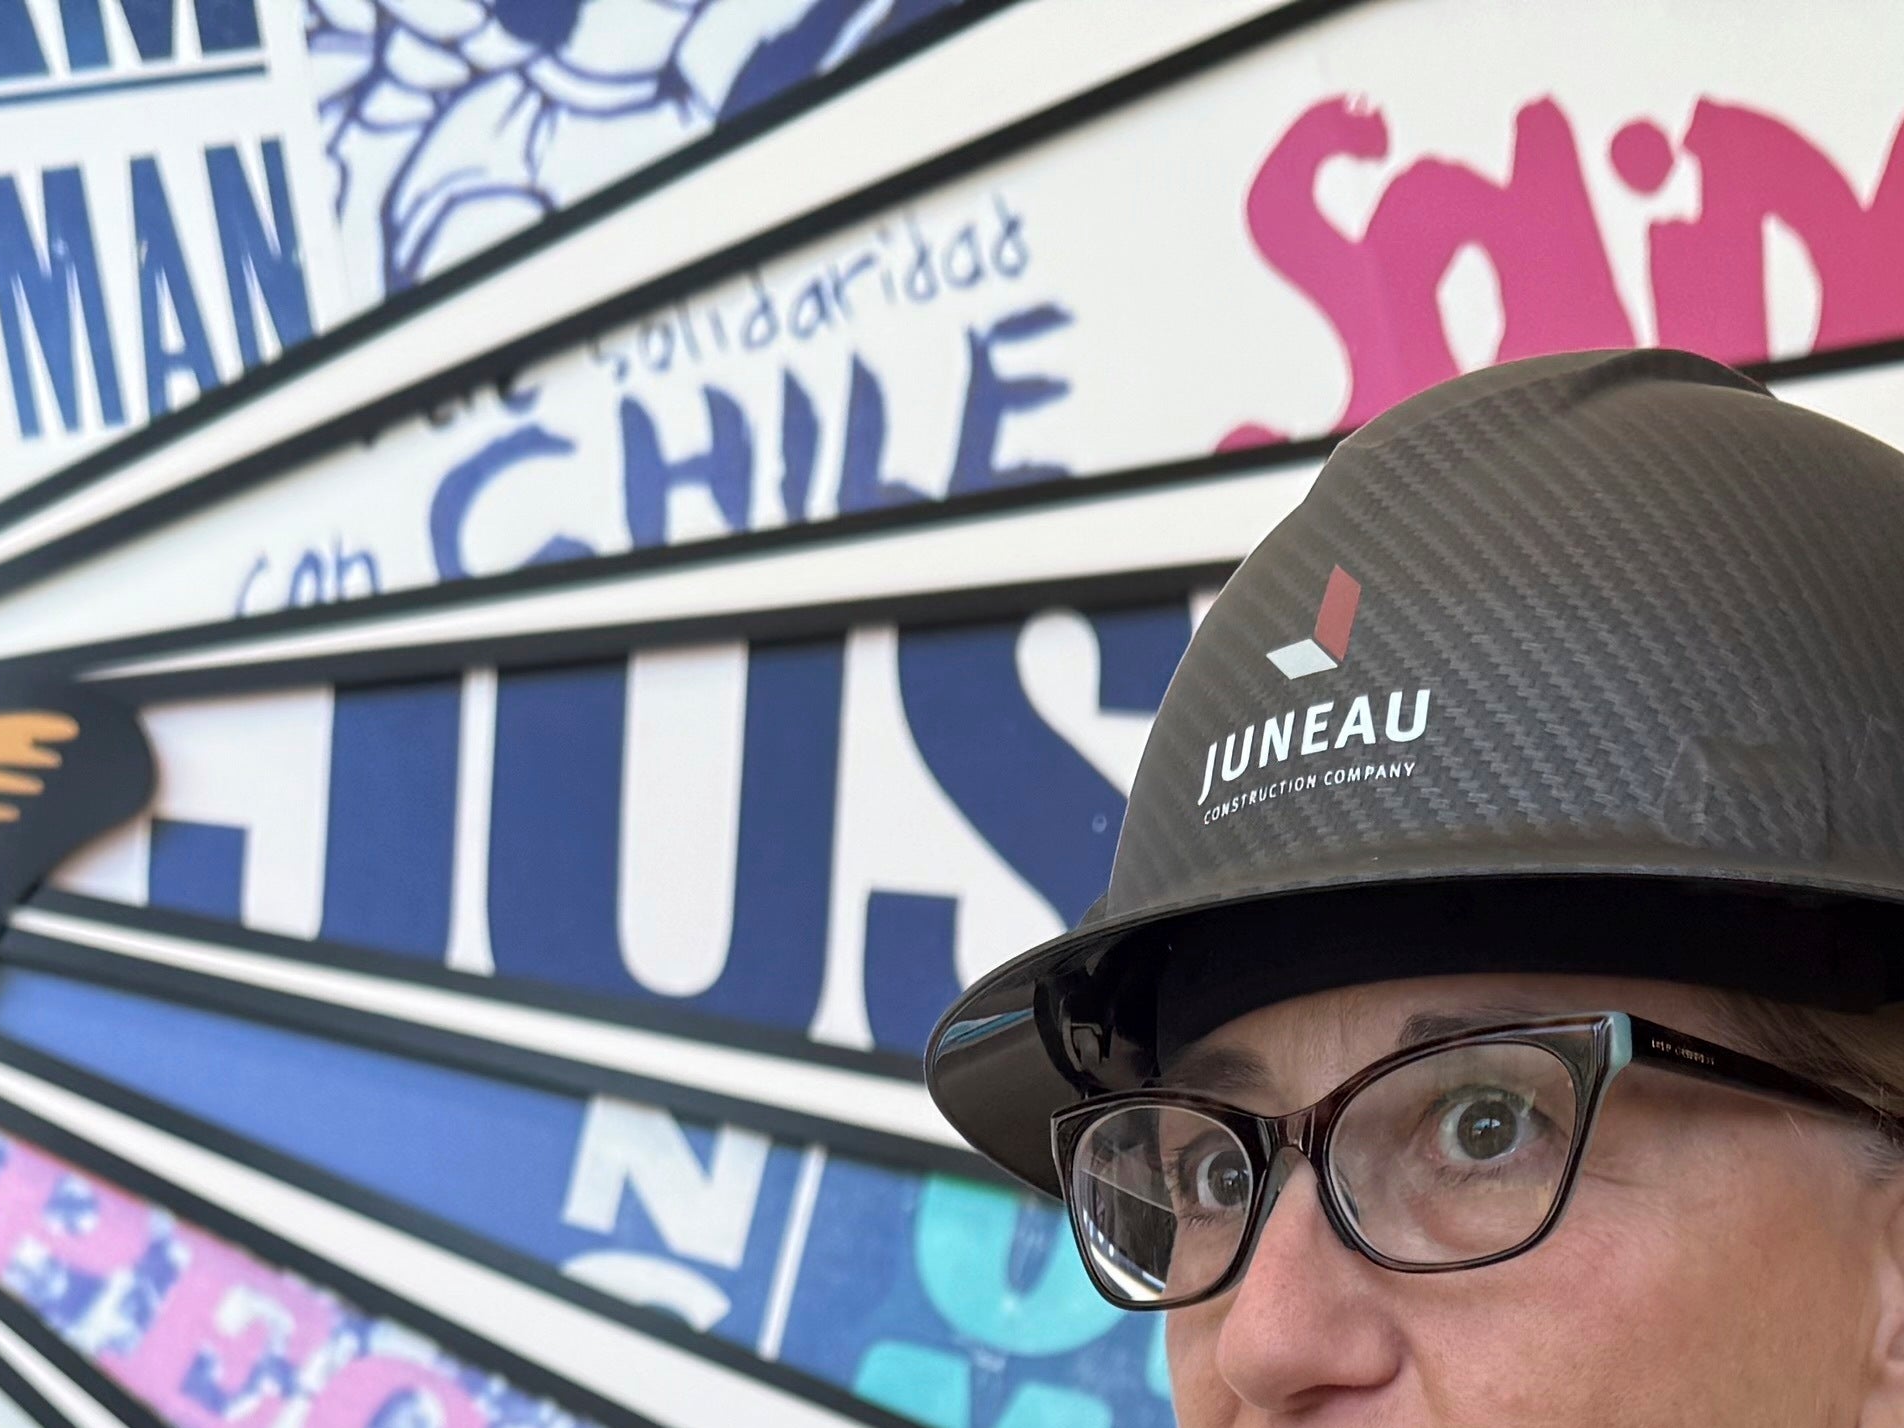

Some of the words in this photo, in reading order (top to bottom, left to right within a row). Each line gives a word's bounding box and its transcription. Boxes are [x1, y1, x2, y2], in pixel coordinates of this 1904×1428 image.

[429, 300, 1078, 588] CHILE
[1197, 688, 1432, 806] JUNEAU
[1202, 774, 1318, 826] CONSTRUCTION
[1323, 761, 1417, 786] COMPANY
